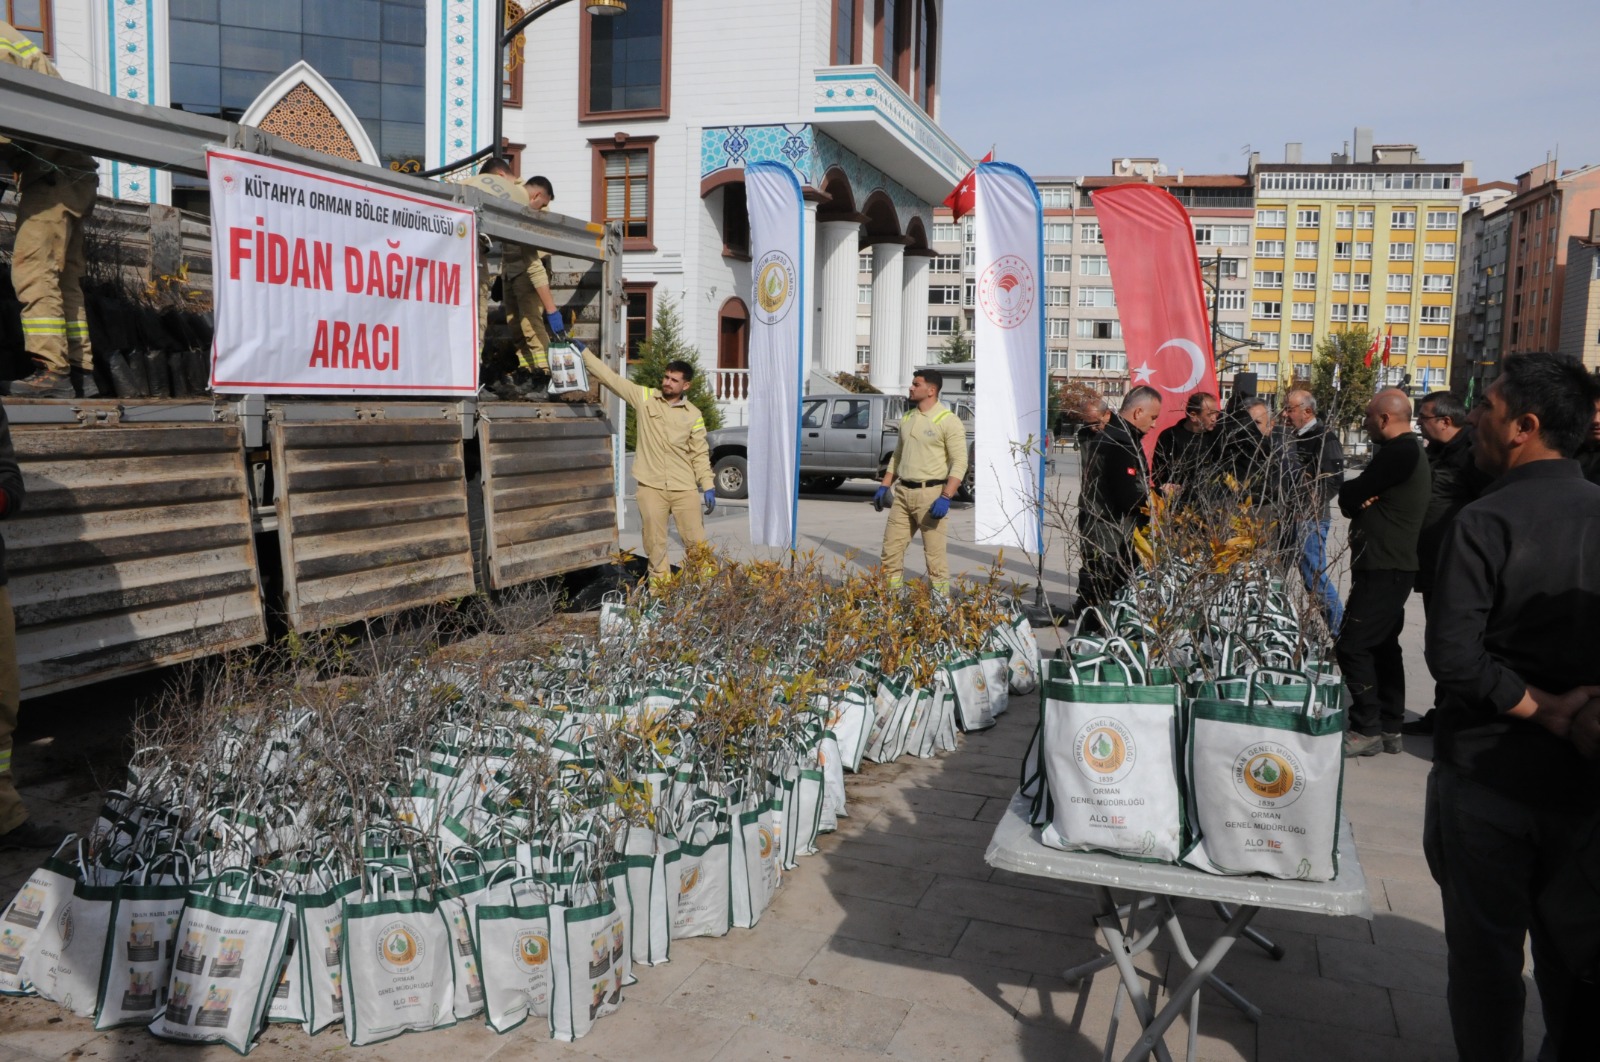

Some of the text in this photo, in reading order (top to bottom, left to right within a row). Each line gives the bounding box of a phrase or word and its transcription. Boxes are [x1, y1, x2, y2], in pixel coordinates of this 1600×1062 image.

[245, 174, 305, 207] KÜTAHYA
[309, 191, 352, 216] ORMAN
[355, 199, 389, 224] BÖLGE
[392, 207, 454, 236] MÜDÜRLÜĞÜ
[229, 216, 461, 306] FİDAN DAĞITIM
[309, 319, 399, 372] ARACI
[1076, 720, 1134, 763] ORMAN GENEL MÜDÜRLÜĞÜ
[1236, 745, 1303, 792] ORMAN GENEL MÜDÜRLÜĞÜ
[1070, 796, 1145, 807] GENEL MÜDÜRLÜĞÜ
[1251, 811, 1281, 820] ORMAN
[1089, 814, 1126, 824] ALO 112
[1225, 821, 1306, 835] GENEL MÜDÜRLÜĞÜ
[1245, 838, 1283, 849] ALO 112
